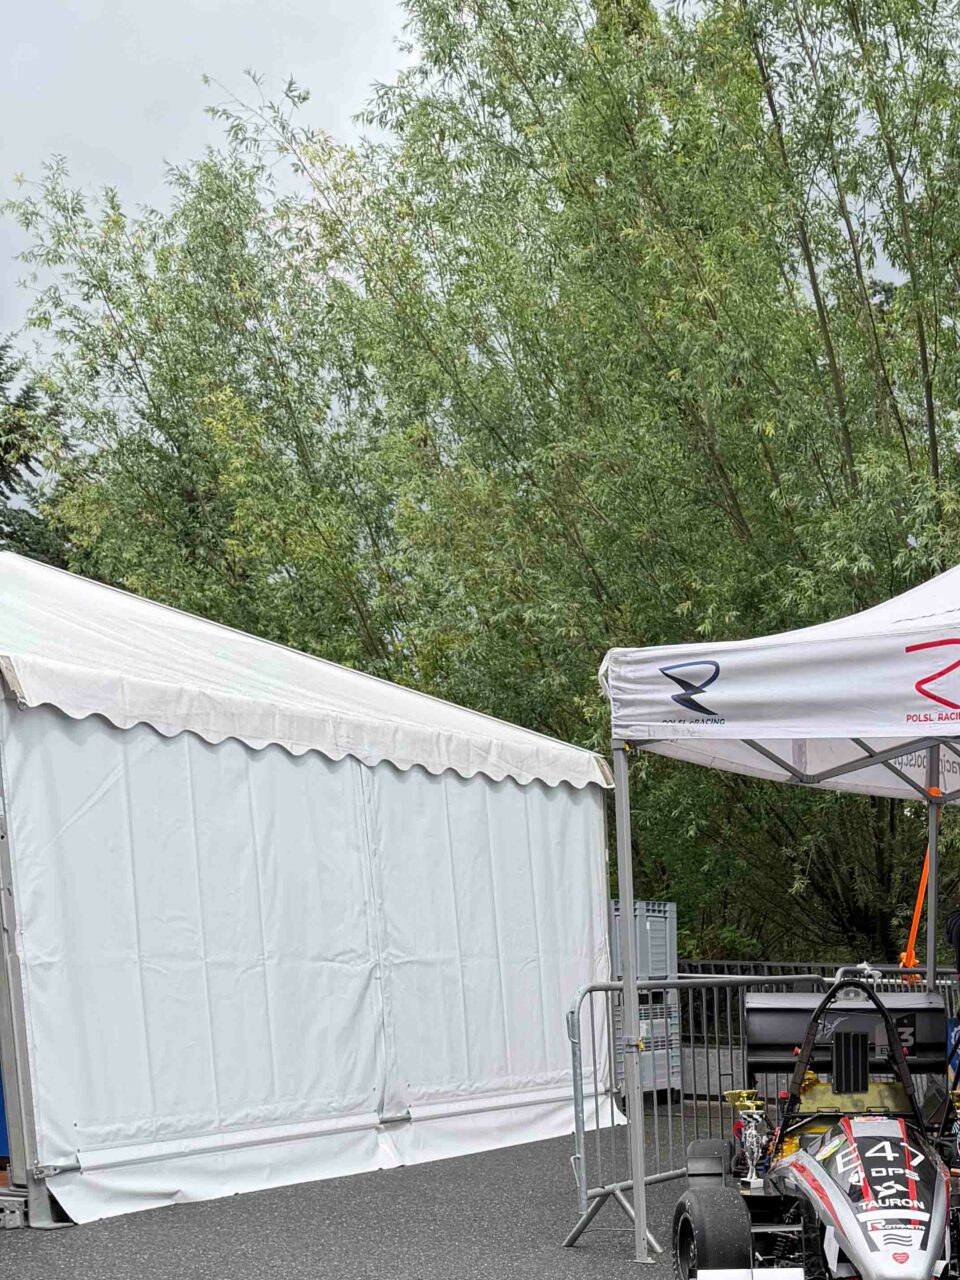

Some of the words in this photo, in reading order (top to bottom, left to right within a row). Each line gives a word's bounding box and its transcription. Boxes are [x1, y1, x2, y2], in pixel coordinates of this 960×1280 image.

[906, 714, 934, 723] POLSL
[871, 1167, 921, 1181] DPS
[858, 1198, 925, 1210] TAURON
